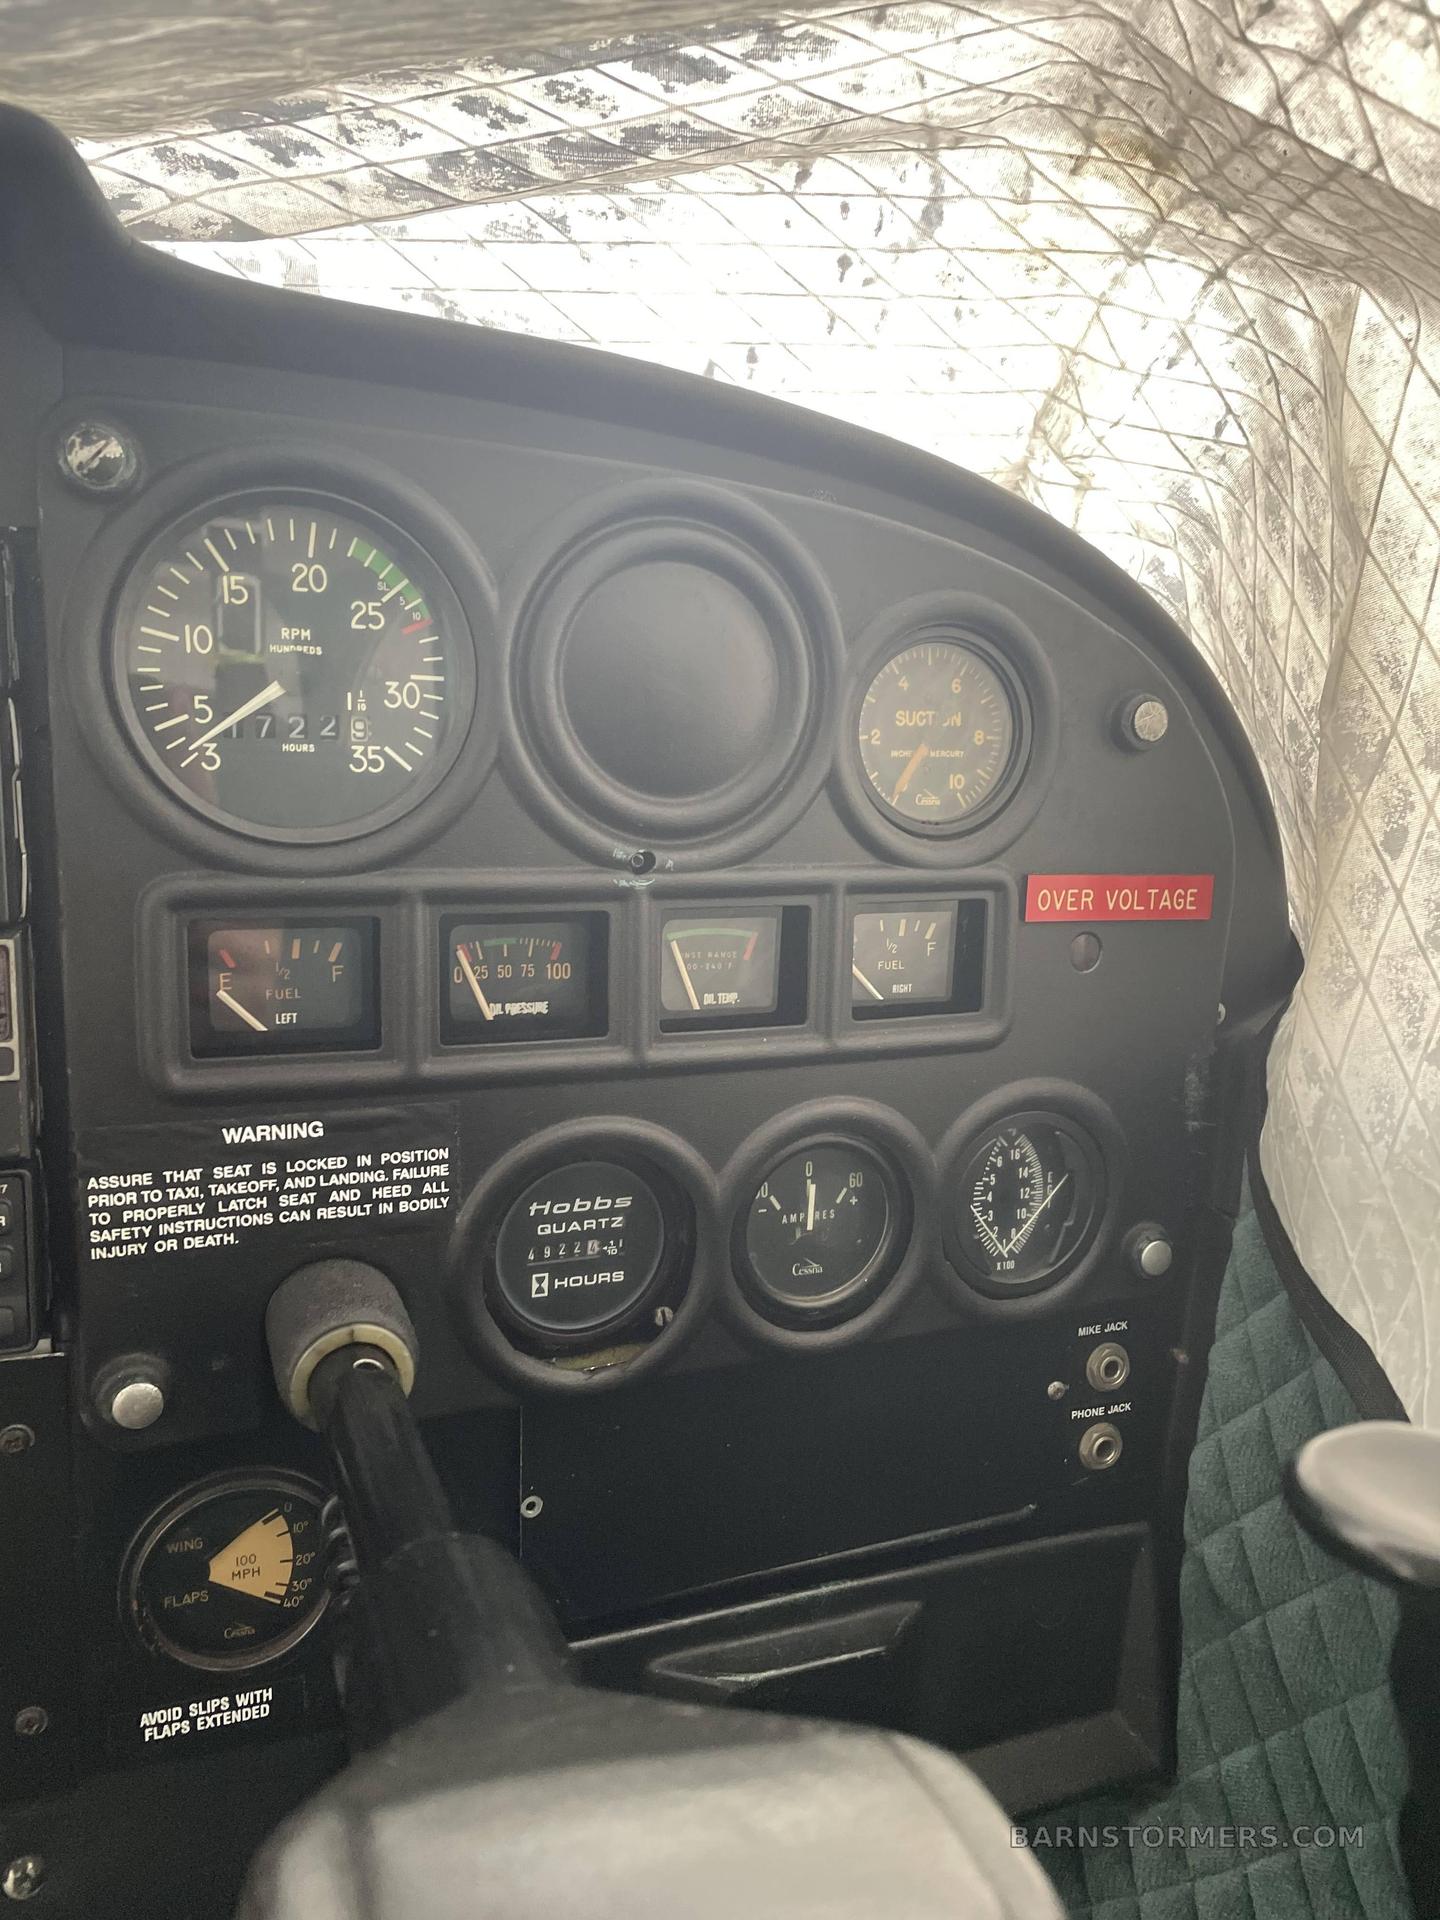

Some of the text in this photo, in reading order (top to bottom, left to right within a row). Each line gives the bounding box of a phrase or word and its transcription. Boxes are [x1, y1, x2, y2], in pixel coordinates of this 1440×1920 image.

[291, 562, 328, 593] 20
[223, 574, 249, 605] 15
[377, 582, 390, 591] SL
[351, 600, 385, 630] 25
[185, 623, 214, 655] 10
[281, 627, 311, 641] RPM
[898, 676, 909, 691] 4
[952, 678, 962, 694] 6
[384, 681, 421, 710] 30
[193, 695, 214, 724] 5
[895, 709, 962, 727] SUCTN
[870, 728, 881, 745] 2
[974, 730, 985, 746] 8
[282, 743, 315, 753] HOURS
[201, 743, 222, 771] 3
[349, 745, 385, 773] 35
[949, 773, 965, 790] 10
[1037, 888, 1198, 911] OVER VOLTAGE
[926, 941, 937, 957] F
[332, 964, 344, 983] F
[453, 962, 571, 984] 0 25 50 75 100
[878, 960, 905, 971] FUEL
[219, 972, 233, 992] E
[892, 983, 913, 994] RIGHT
[265, 988, 302, 1000] FUEL
[505, 1001, 549, 1016] PRESSURE
[275, 1012, 298, 1024] LEFT
[222, 1121, 324, 1144] WARNING
[1010, 1148, 1021, 1161] 16
[87, 1148, 449, 1190] ASSURE THAT SEAT IS LOCKED IN POSITION
[805, 1161, 813, 1177] 0
[1018, 1166, 1029, 1179] 14
[88, 1192, 137, 1208] PRIOR
[141, 1190, 162, 1203] TO
[166, 1186, 204, 1201] TAXI,
[208, 1181, 279, 1197] TAKEOFF,
[284, 1176, 316, 1190] AND
[393, 1164, 449, 1180] FAILURE
[849, 1172, 863, 1188] 60
[990, 1173, 996, 1186] 5
[986, 1191, 993, 1203] 4
[1020, 1187, 1030, 1200] 12
[89, 1181, 449, 1226] TO PROPERLY LATCH SEAT AND HEED ALL
[529, 1196, 633, 1217] Hobbs
[90, 1196, 450, 1242] SAFETY INSTRUCTIONS CAN RESULT IN BODILY
[781, 1208, 836, 1225] AMPRES
[987, 1210, 993, 1221] 3
[1016, 1207, 1027, 1220] 10
[537, 1216, 624, 1235] QUARTZ
[91, 1232, 239, 1259] INJURY OR DEATH.
[792, 1258, 823, 1277] Cessna
[1002, 1260, 1015, 1270] 100
[554, 1271, 625, 1289] HOURS
[1078, 1320, 1128, 1337] MIKE JACK
[1071, 1402, 1132, 1420] PHONE JACK
[167, 1537, 204, 1554] WING
[235, 1554, 257, 1567] 100
[231, 1567, 261, 1582] MPH
[164, 1590, 209, 1609] FLAPS
[140, 1688, 273, 1728] AVOID SLIPS WITH
[144, 1703, 270, 1742] FLAPS EXTENDED
